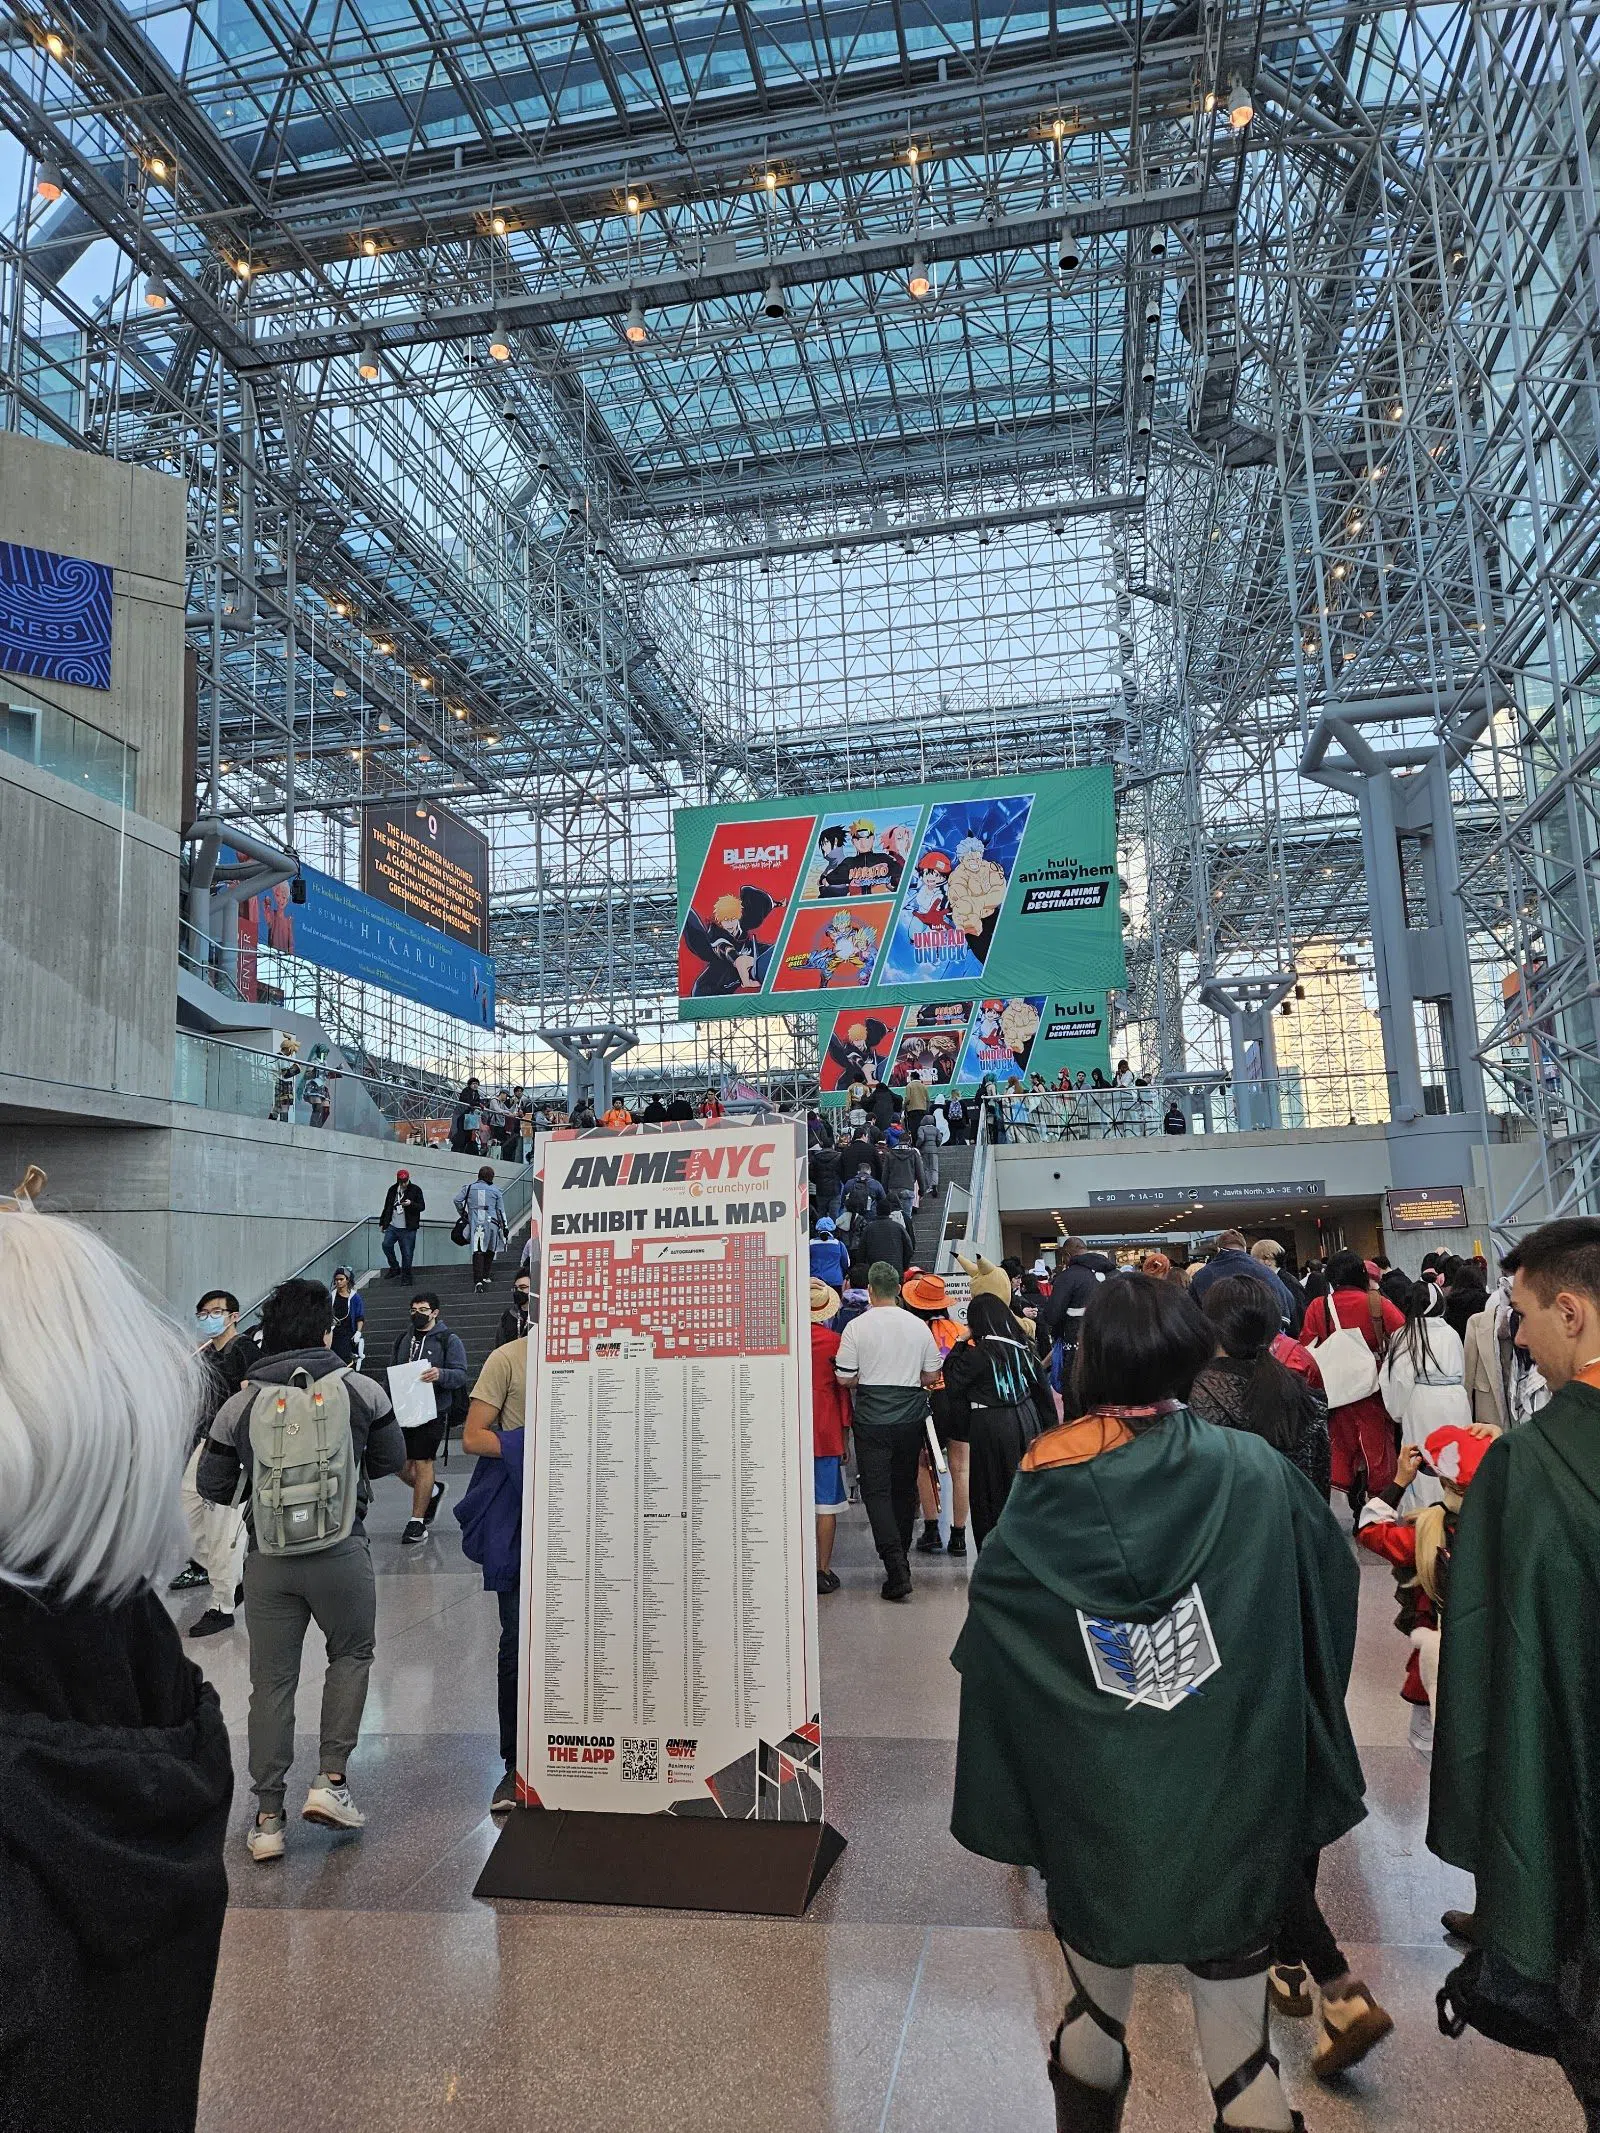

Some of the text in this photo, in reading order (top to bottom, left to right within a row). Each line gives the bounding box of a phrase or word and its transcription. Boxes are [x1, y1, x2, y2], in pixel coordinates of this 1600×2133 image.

[387, 822, 473, 883] THE JAVITS CENTER HAS JOINED
[724, 844, 788, 865] BLEACH
[373, 828, 483, 904] THE NET ZERO CARBON EVENTS PLEDGE,
[849, 862, 889, 880] NARUTO
[1048, 857, 1078, 869] hulu
[387, 852, 474, 910] A GLOBAL INDUSTRY EFFORT TO
[375, 859, 400, 881] TACKLE
[400, 874, 426, 895] CLIMATE
[426, 889, 450, 909] CHANGE
[450, 903, 461, 915] AND
[461, 907, 482, 928] REDUCE
[389, 882, 430, 911] GREENHOUSE
[431, 905, 442, 918] GAS
[1031, 886, 1100, 901] YOUR ANIME
[1027, 896, 1101, 911] DESTINATION
[319, 907, 354, 930] SUMMER
[362, 922, 435, 968] HIKARU
[914, 929, 966, 949] UNDEAD
[915, 945, 966, 964] UNLUCK
[441, 962, 467, 982] DIED
[1055, 1002, 1095, 1017] hulu
[1049, 1029, 1097, 1038] DESTINATION
[1072, 1022, 1096, 1030] ANIME
[980, 1048, 1013, 1061] UNDEAD
[698, 1143, 776, 1180] NYC
[707, 1182, 769, 1195] crunchyroll
[1244, 1187, 1265, 1196] North,
[1107, 1194, 1116, 1202] 2D
[551, 1200, 787, 1236] EXHIBIT HALL MAP
[548, 1734, 615, 1747] DOWNLOAD
[548, 1747, 615, 1763] THE APP
[678, 1748, 697, 1758] NYC
